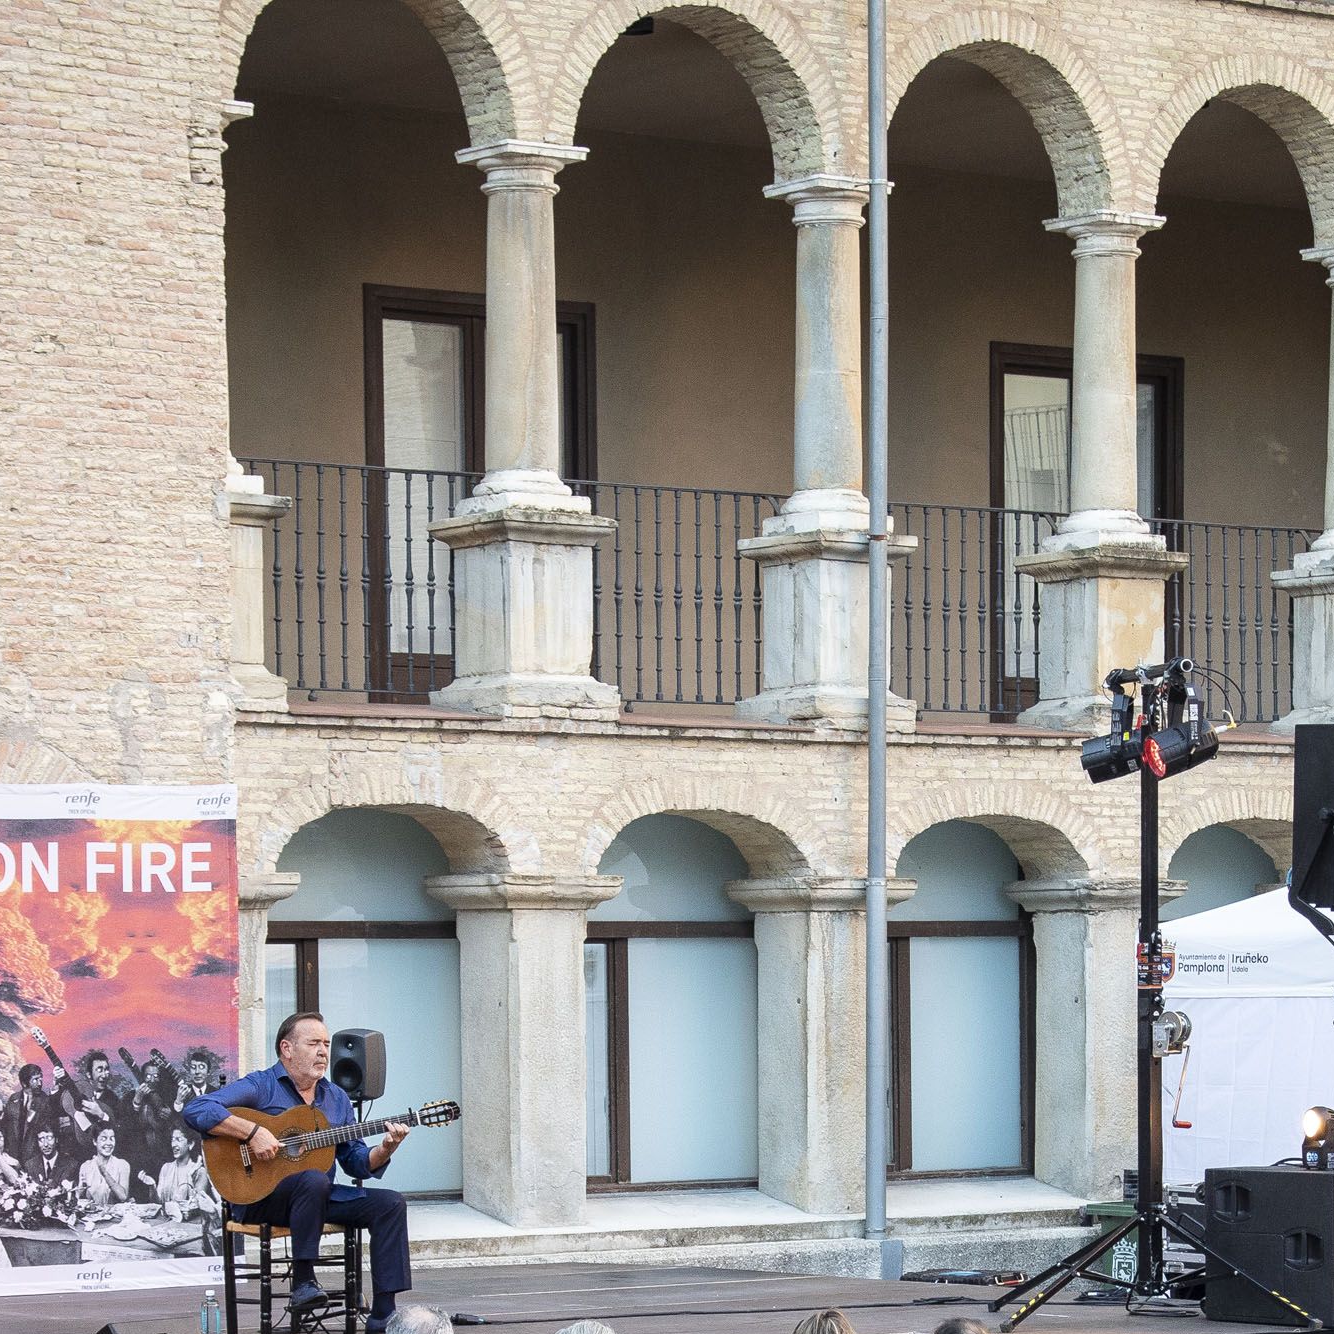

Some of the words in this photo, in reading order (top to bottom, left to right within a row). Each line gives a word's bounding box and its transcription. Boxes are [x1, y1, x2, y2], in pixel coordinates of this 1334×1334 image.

[65, 791, 101, 807] renfe
[196, 792, 231, 809] renfe
[85, 842, 213, 894] FIRE
[1178, 953, 1218, 962] Ayuntamiento
[1218, 953, 1226, 961] de
[1231, 953, 1269, 964] Iruñeko
[1178, 962, 1225, 976] Pamplona
[76, 1266, 113, 1283] renfe
